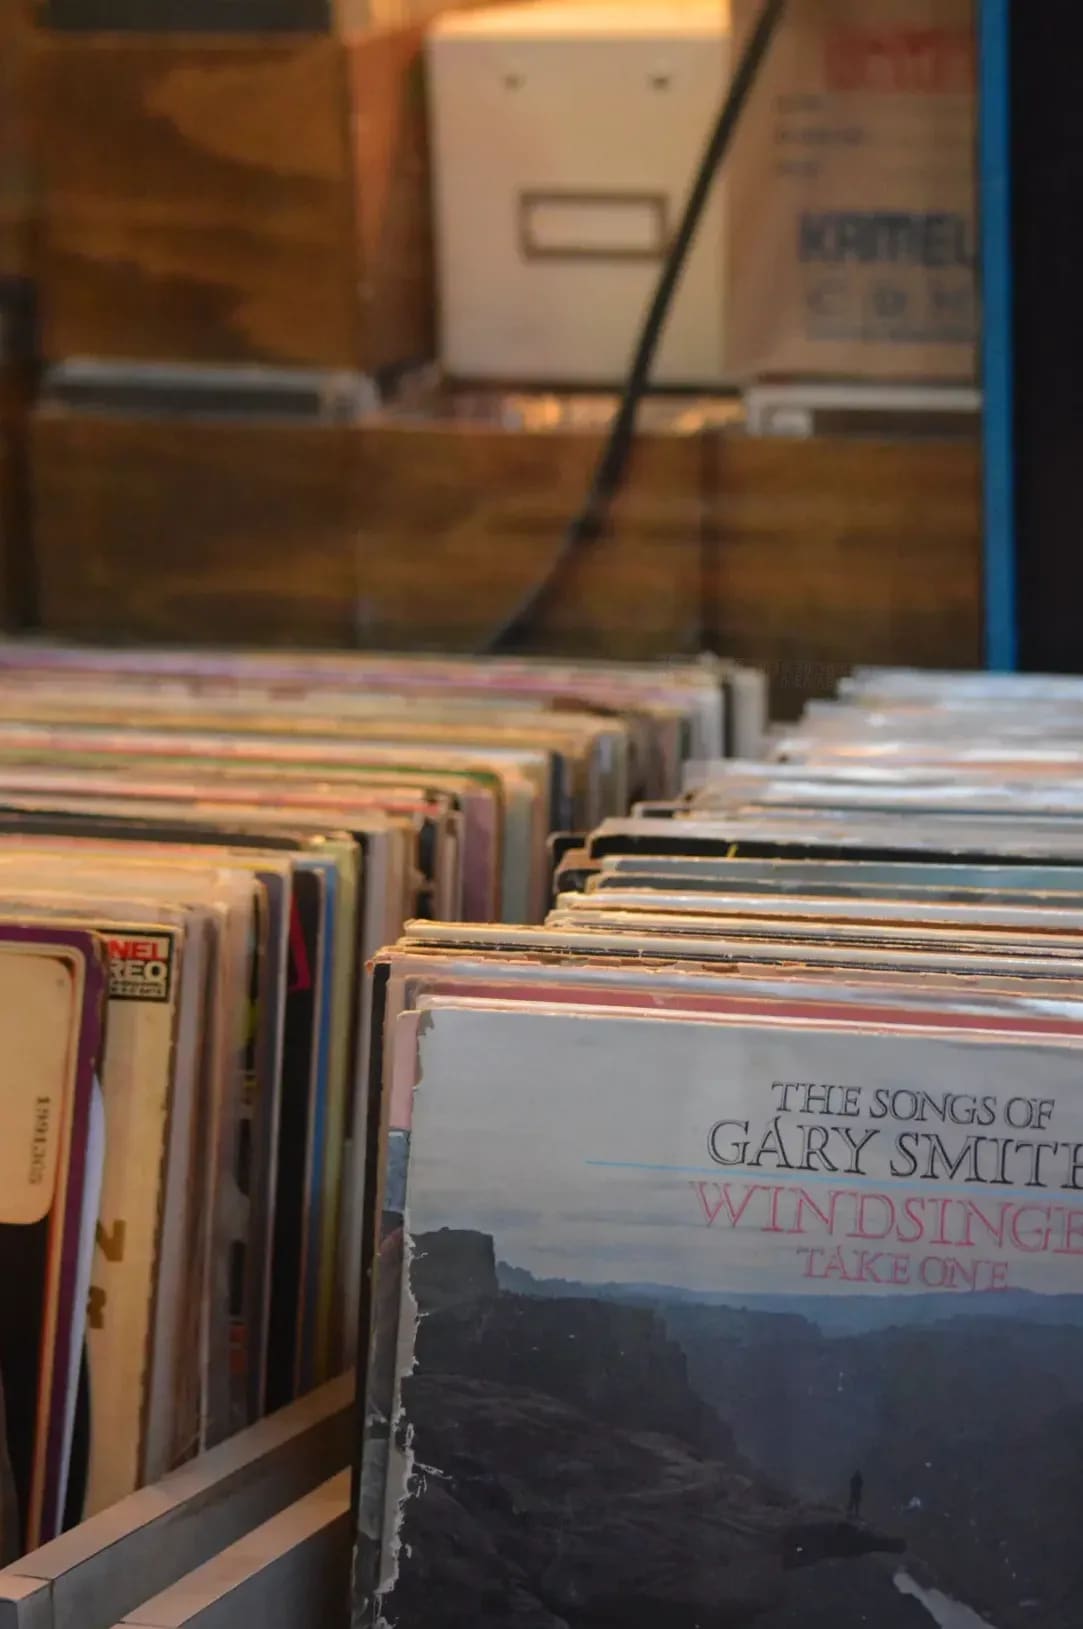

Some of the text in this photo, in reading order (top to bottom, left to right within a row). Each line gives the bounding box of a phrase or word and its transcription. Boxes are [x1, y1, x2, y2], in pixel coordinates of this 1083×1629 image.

[771, 1081, 1056, 1130] THE SONGS OF
[707, 1115, 880, 1175] GARY
[796, 1246, 1012, 1292] TAKE ONE
